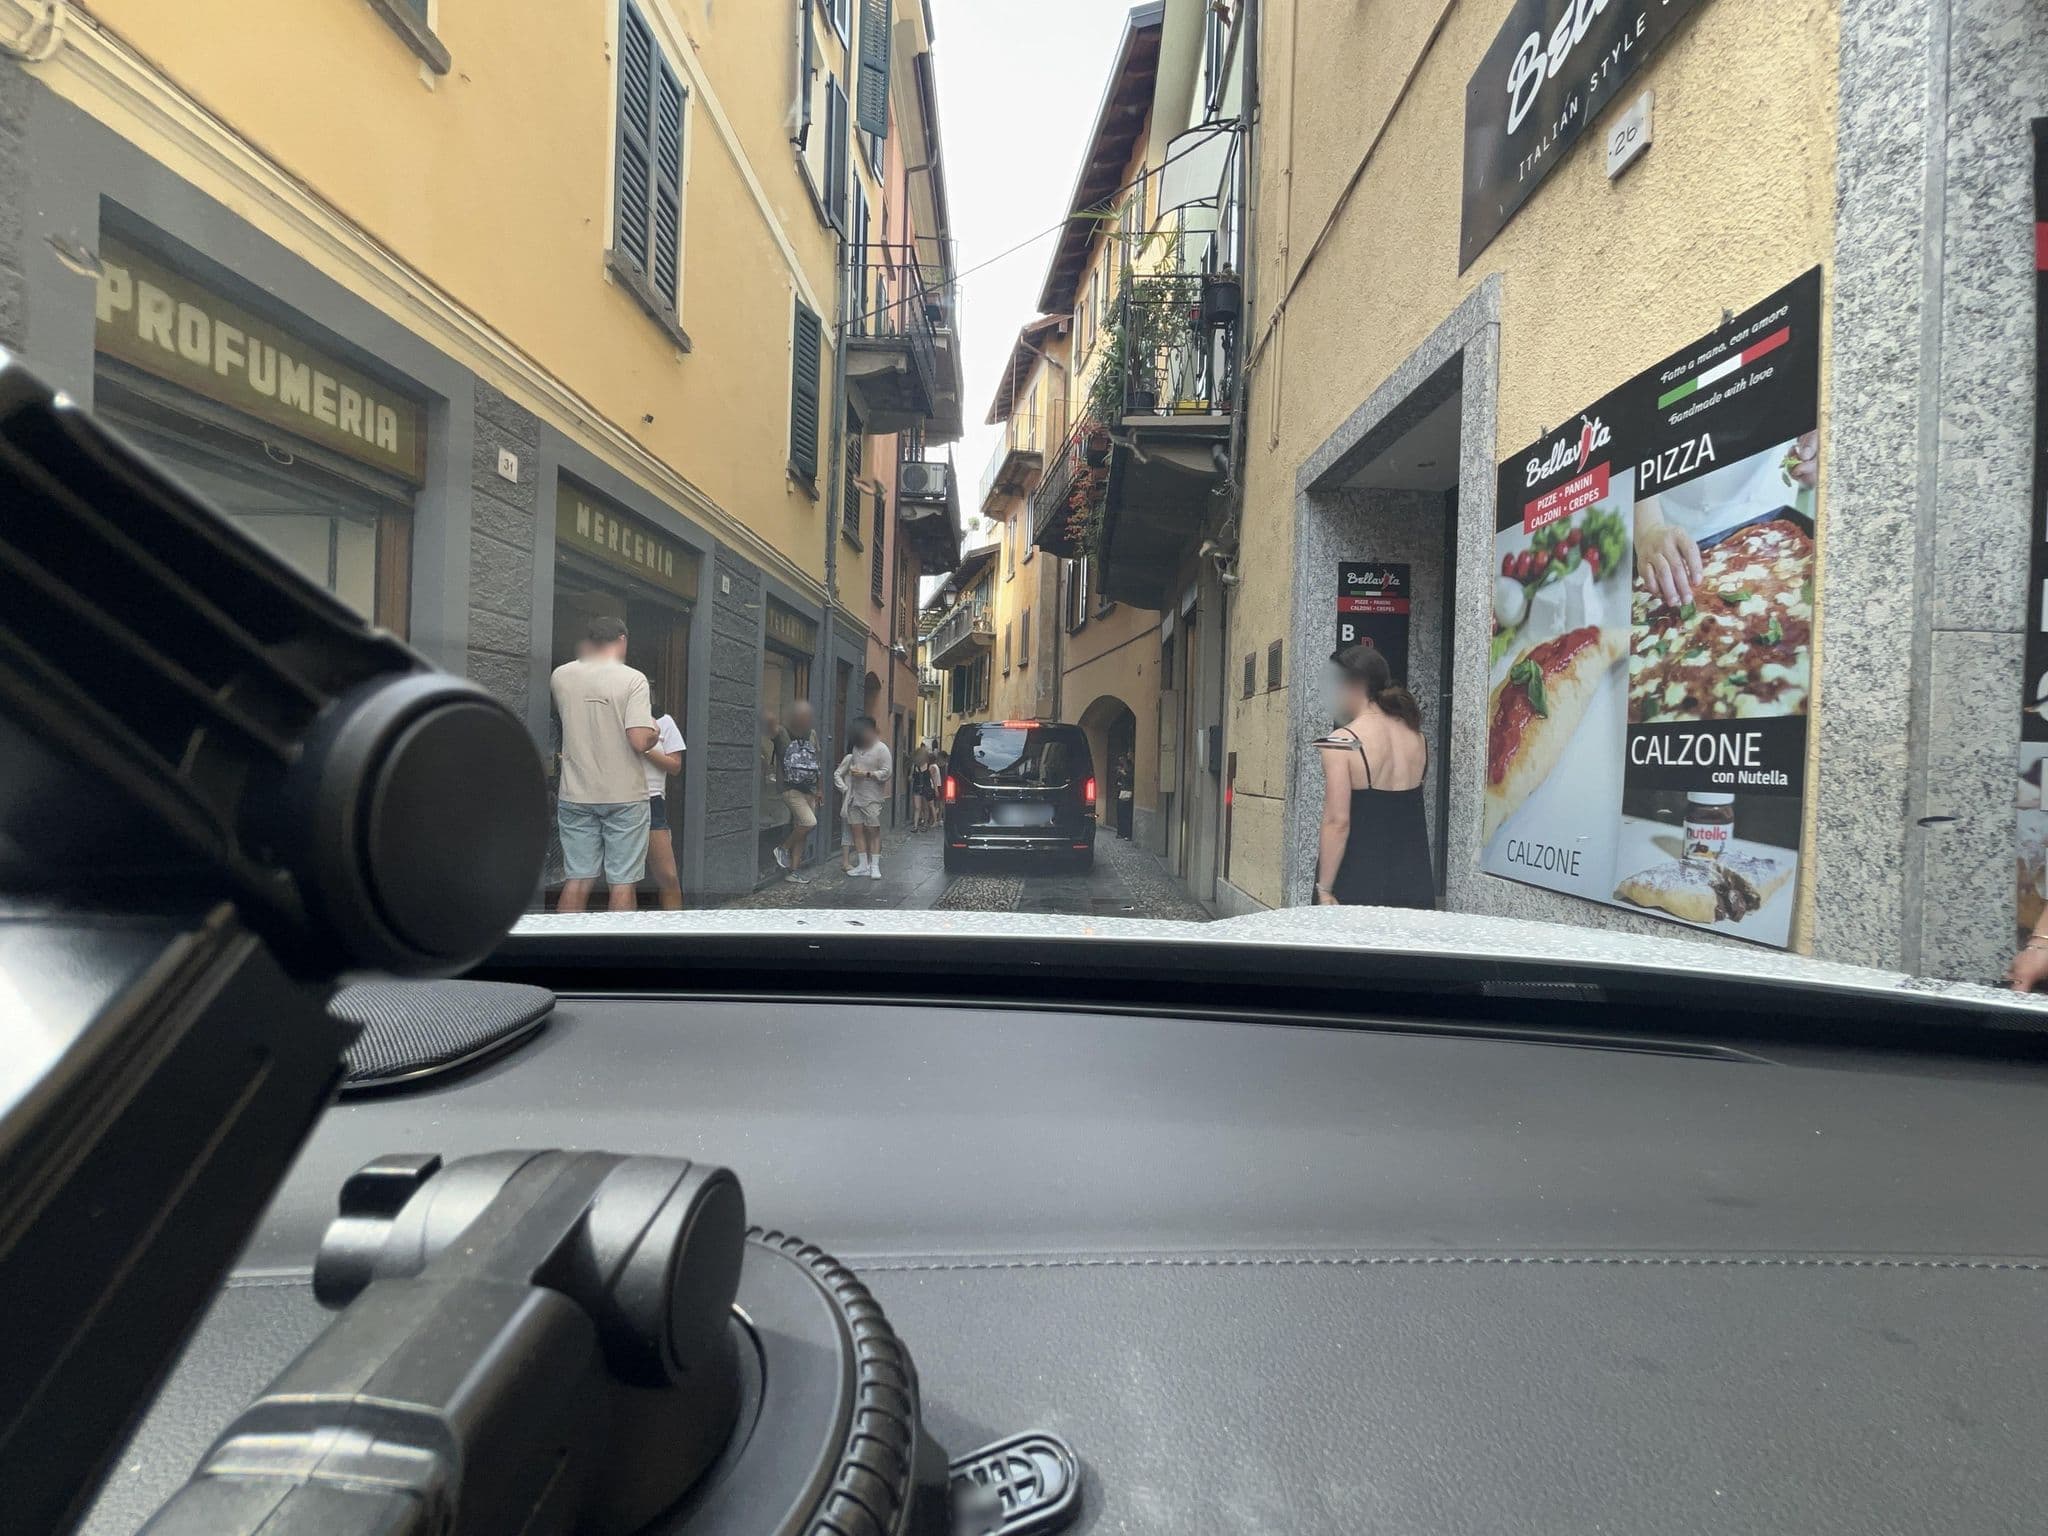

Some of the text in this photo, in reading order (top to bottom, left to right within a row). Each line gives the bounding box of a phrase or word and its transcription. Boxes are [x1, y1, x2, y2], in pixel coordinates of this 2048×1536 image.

[1518, 12, 1648, 183] ITALIAN STYLE
[1614, 125, 1638, 156] 26
[1729, 328, 1750, 346] con
[1751, 305, 1789, 334] amore
[96, 260, 397, 453] PROFUMERIA
[1724, 378, 1747, 397] with
[1748, 366, 1774, 386] love
[503, 458, 514, 473] 31
[1640, 433, 1716, 490] PIZZA
[1531, 488, 1600, 529] CALZONI CREPES
[1537, 473, 1593, 511] PIZZE PANINI
[576, 501, 674, 578] MERCERIA
[1631, 732, 1763, 767] CALZONE
[1712, 770, 1788, 786] con Nutella
[1686, 826, 1728, 841] nutella
[1507, 839, 1582, 877] CALZONE
